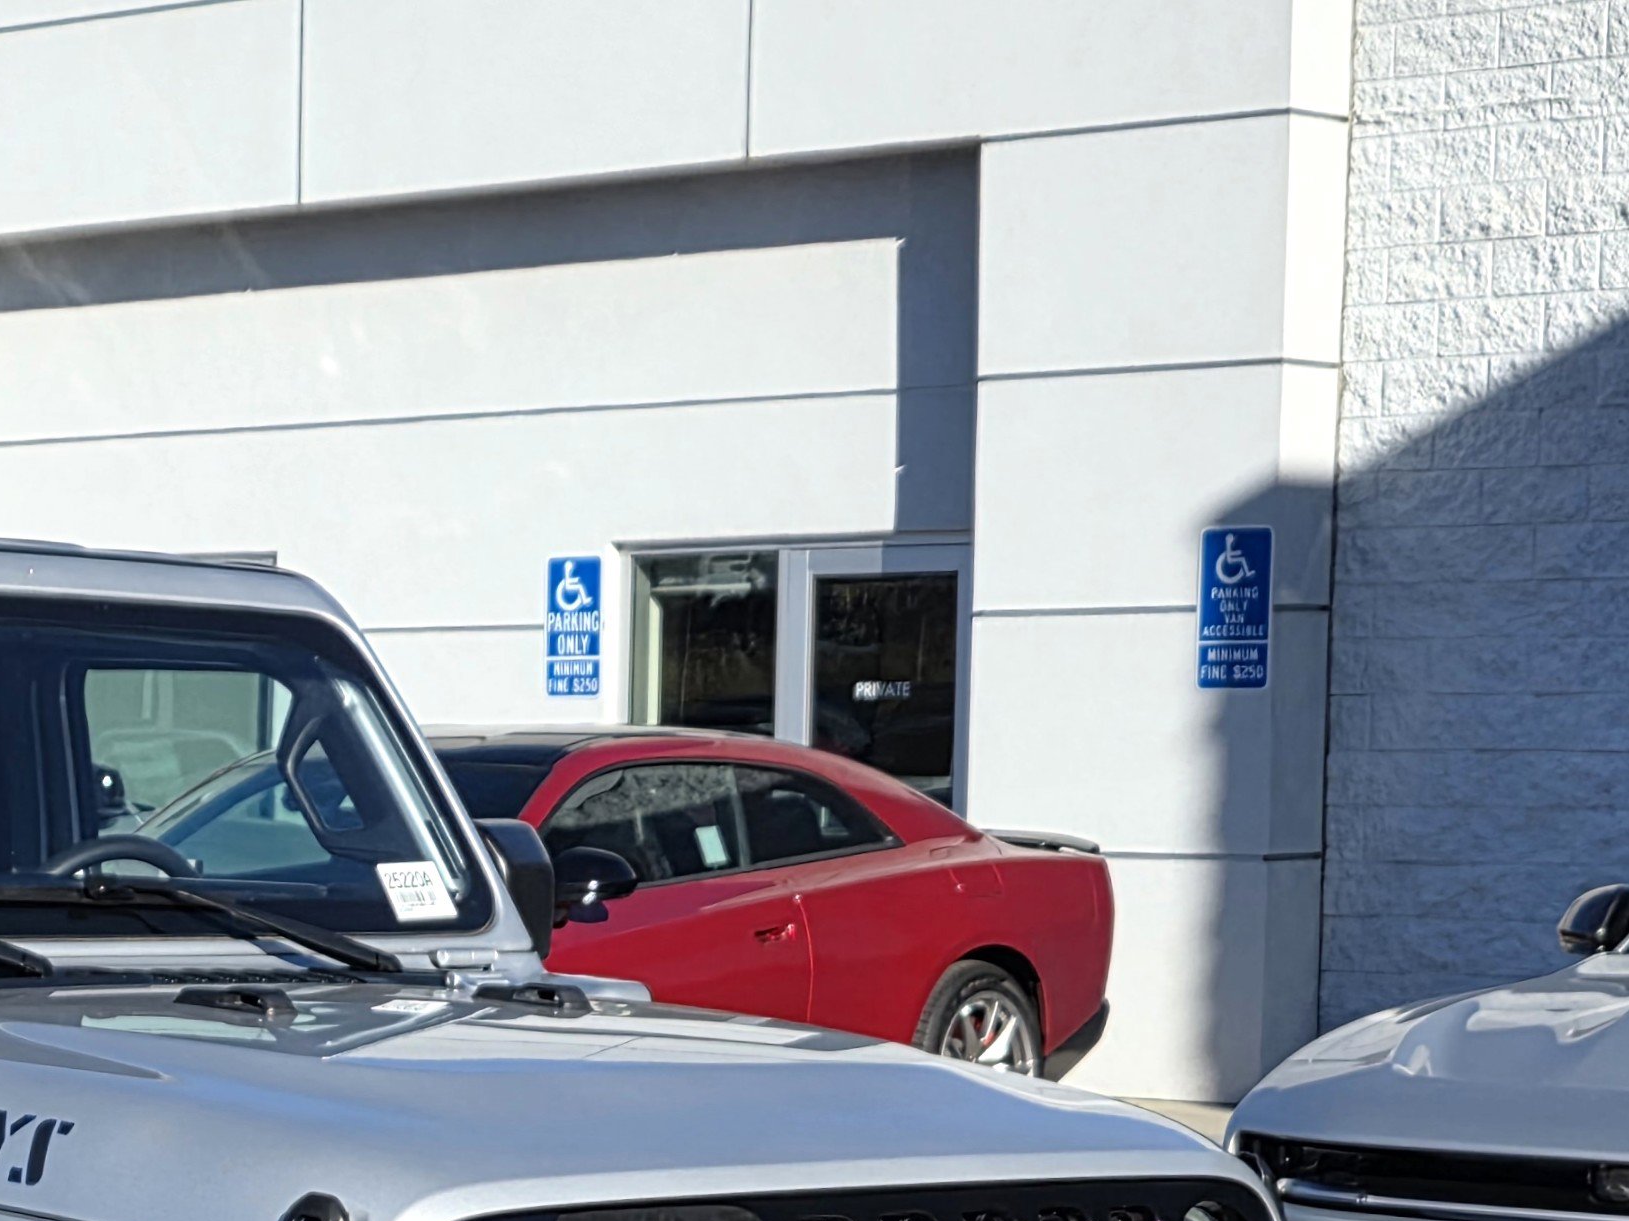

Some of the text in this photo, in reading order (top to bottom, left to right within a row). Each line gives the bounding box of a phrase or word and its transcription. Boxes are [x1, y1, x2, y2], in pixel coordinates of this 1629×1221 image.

[1211, 586, 1259, 599] PARKING
[1220, 600, 1248, 612] ONLY
[548, 611, 600, 632] PARKING
[1224, 613, 1244, 624] VAN
[1203, 625, 1264, 637] ACCESSIBLE
[557, 634, 589, 655] ONLY
[1207, 648, 1258, 662] MINIMUM
[554, 661, 593, 676] MINIMUM
[1201, 665, 1264, 679] FINE $250
[549, 678, 598, 692] FINE $250
[854, 680, 911, 698] PRIVATE
